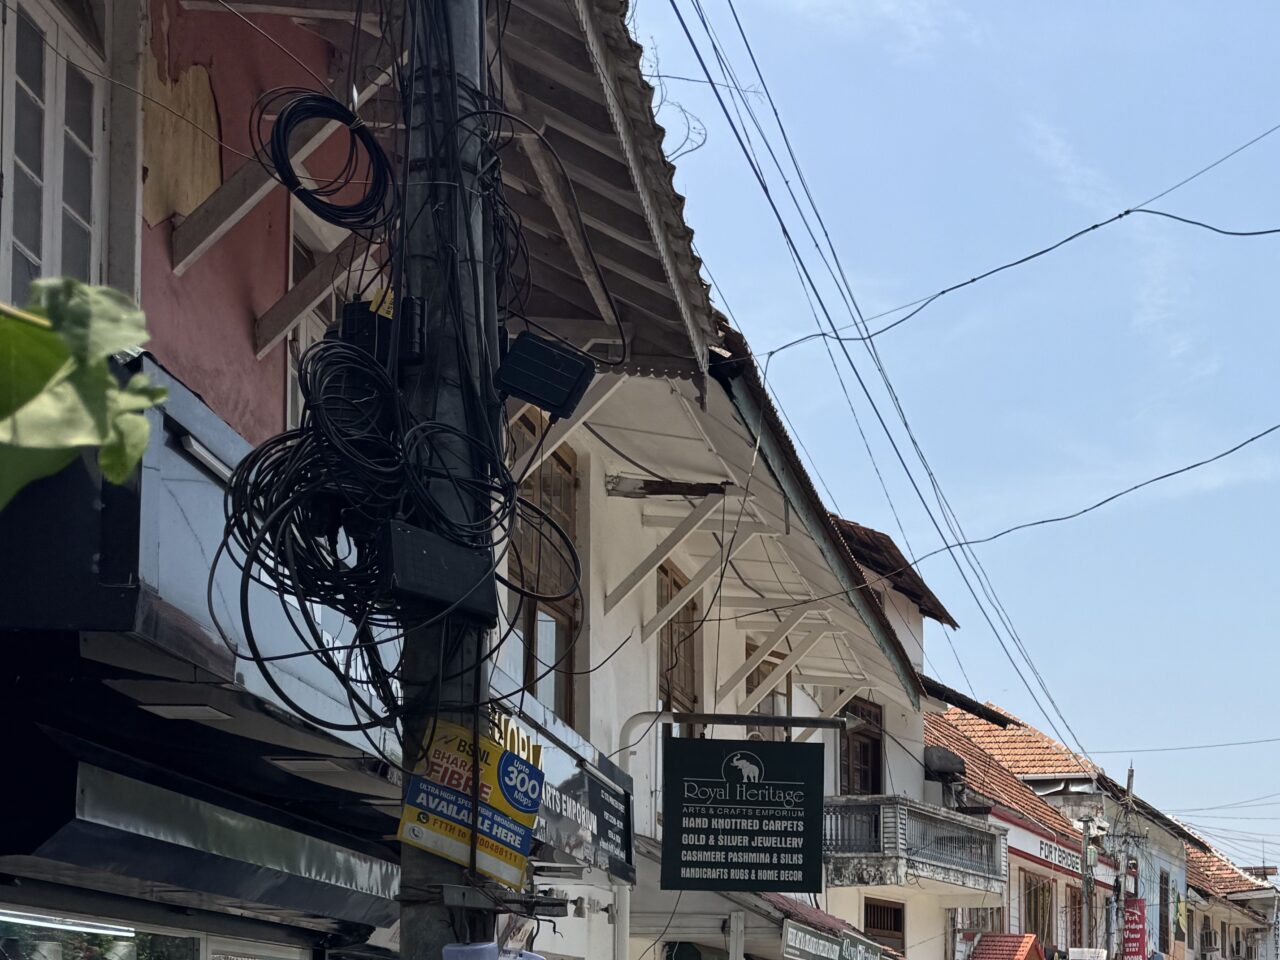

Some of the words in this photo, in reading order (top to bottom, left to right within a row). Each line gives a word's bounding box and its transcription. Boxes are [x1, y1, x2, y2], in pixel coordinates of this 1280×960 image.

[457, 739, 492, 766] BSNL
[513, 759, 530, 774] Upto
[505, 766, 539, 799] 300
[439, 788, 456, 801] HIGH
[513, 790, 531, 807] Mbps
[684, 782, 730, 804] Royal
[736, 784, 804, 808] Heritage
[562, 794, 597, 835] EMPORIUM
[756, 809, 804, 817] EMPORIUM
[683, 817, 708, 828] HAND
[712, 818, 759, 830] KNOTTRED
[763, 819, 804, 831] CARPETS
[492, 826, 522, 848] HERE
[682, 834, 705, 845] GOLD
[709, 835, 715, 845] &
[718, 835, 749, 846] SILVER
[751, 836, 804, 848] JEWELLERY
[681, 851, 726, 862] CASHMERE
[728, 851, 770, 863] PASHMINA
[773, 853, 778, 864] &
[780, 854, 803, 864] SILKS
[681, 867, 728, 879] HANDICRAFTS
[730, 869, 749, 879] RUGS
[751, 869, 756, 880] &
[758, 869, 778, 880] HOME
[780, 870, 803, 881] DECOR
